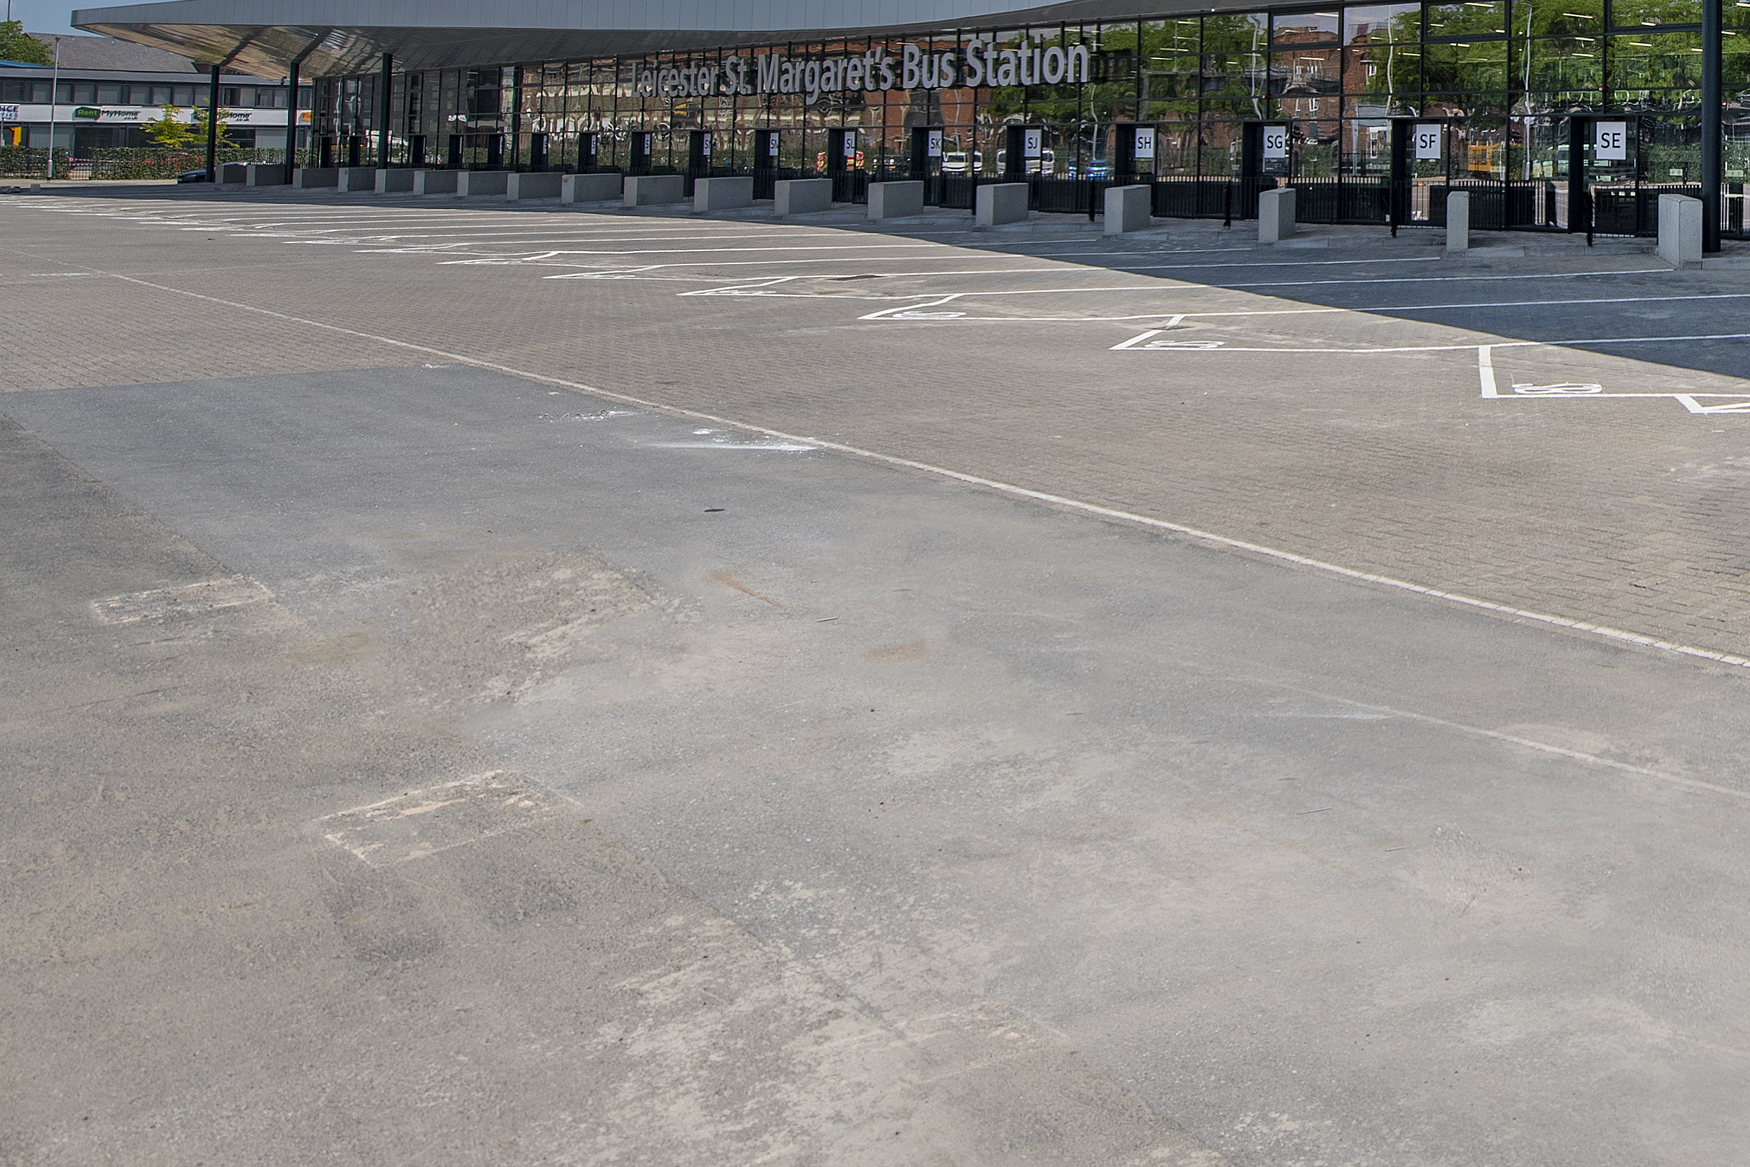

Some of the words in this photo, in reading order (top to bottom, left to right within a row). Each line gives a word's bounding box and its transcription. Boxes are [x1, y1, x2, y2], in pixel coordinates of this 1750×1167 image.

[631, 60, 720, 98] Leicester
[725, 55, 750, 97] St.
[756, 46, 895, 105] Margaret's
[902, 45, 957, 89] Bus
[966, 34, 1091, 88] Station
[930, 137, 941, 150] SK
[1027, 137, 1038, 150] SJ
[1137, 136, 1152, 150] SH
[1266, 135, 1283, 149] SG
[1419, 134, 1437, 149] SF
[1600, 132, 1621, 149] SE
